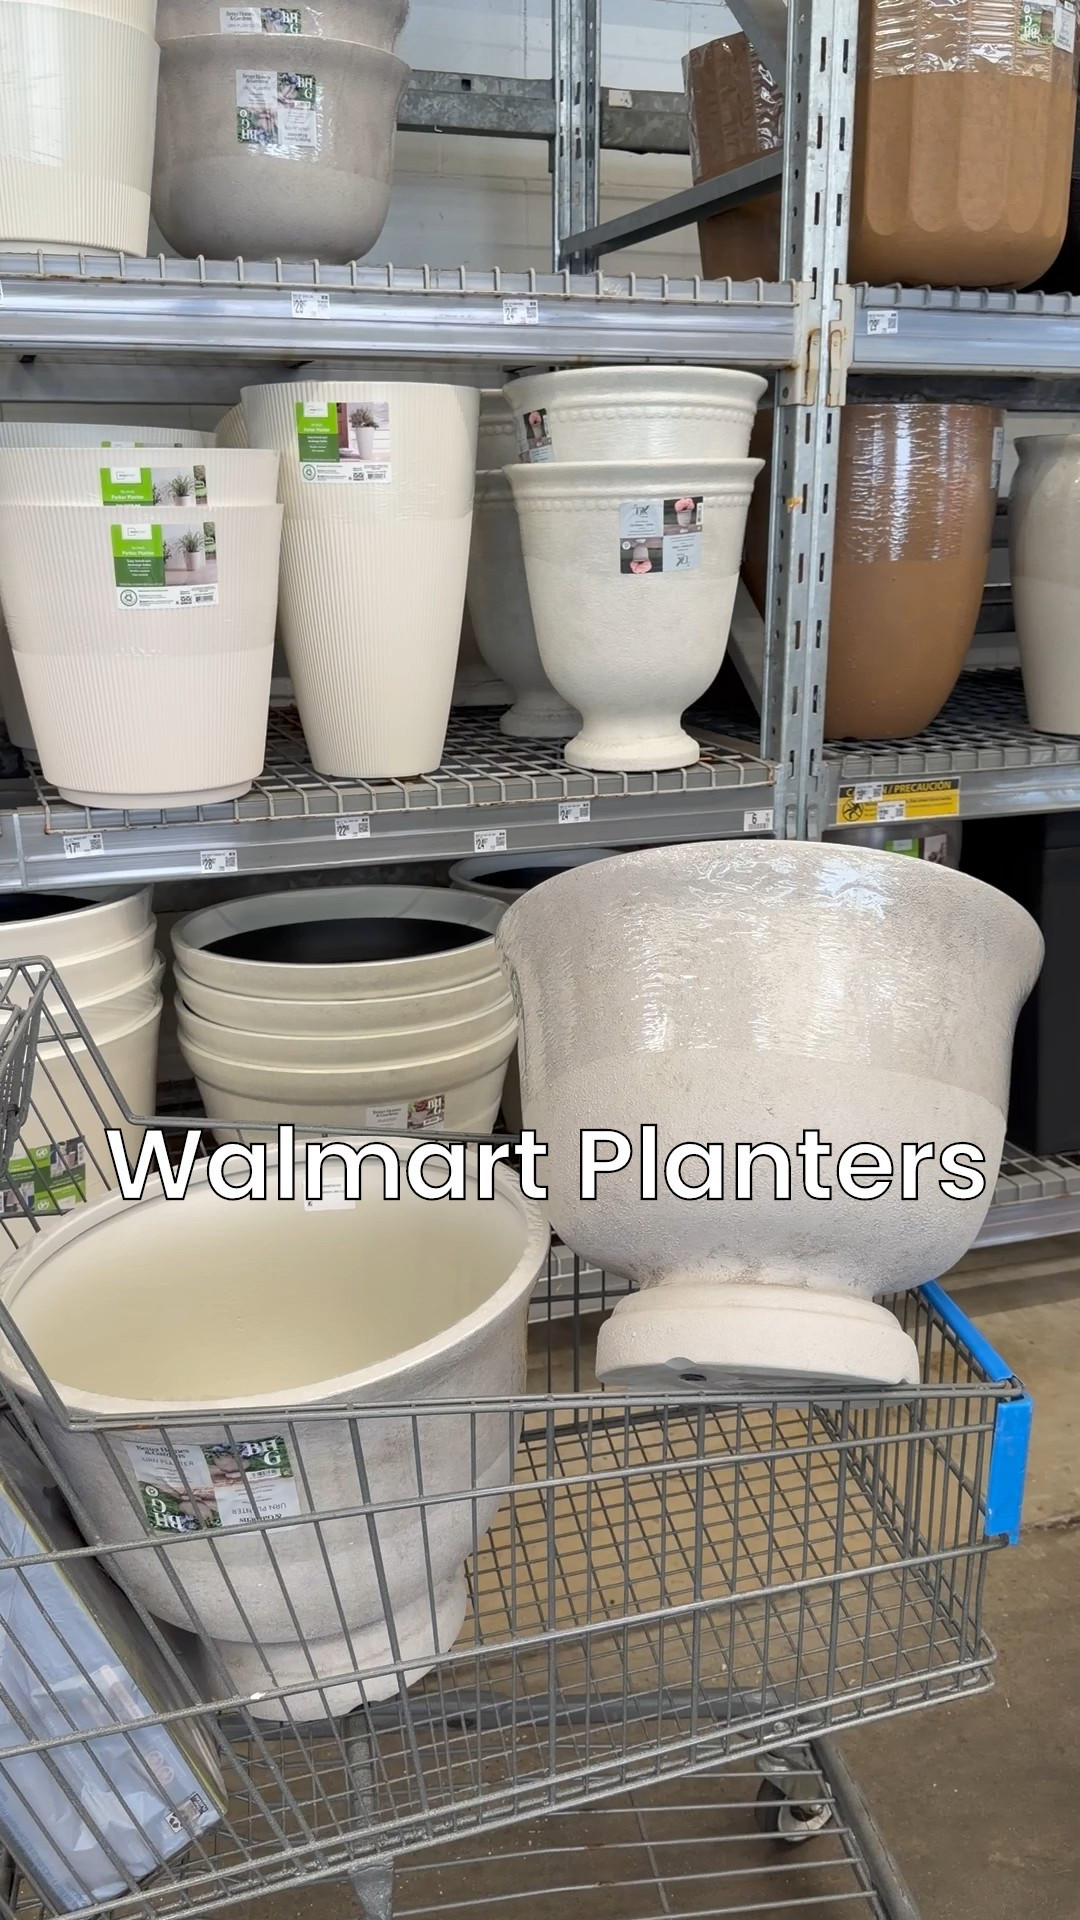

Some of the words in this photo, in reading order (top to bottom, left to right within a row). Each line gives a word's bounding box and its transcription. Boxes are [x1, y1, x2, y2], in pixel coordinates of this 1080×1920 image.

[304, 88, 313, 98] G
[894, 780, 952, 794] PRECAUCIÓN
[752, 812, 757, 825] 6
[246, 1439, 279, 1456] BH
[160, 1459, 195, 1467] PLATER
[263, 1451, 281, 1467] G
[152, 1499, 167, 1514] G
[231, 1505, 268, 1514] PLNTER
[269, 1502, 287, 1511] URN
